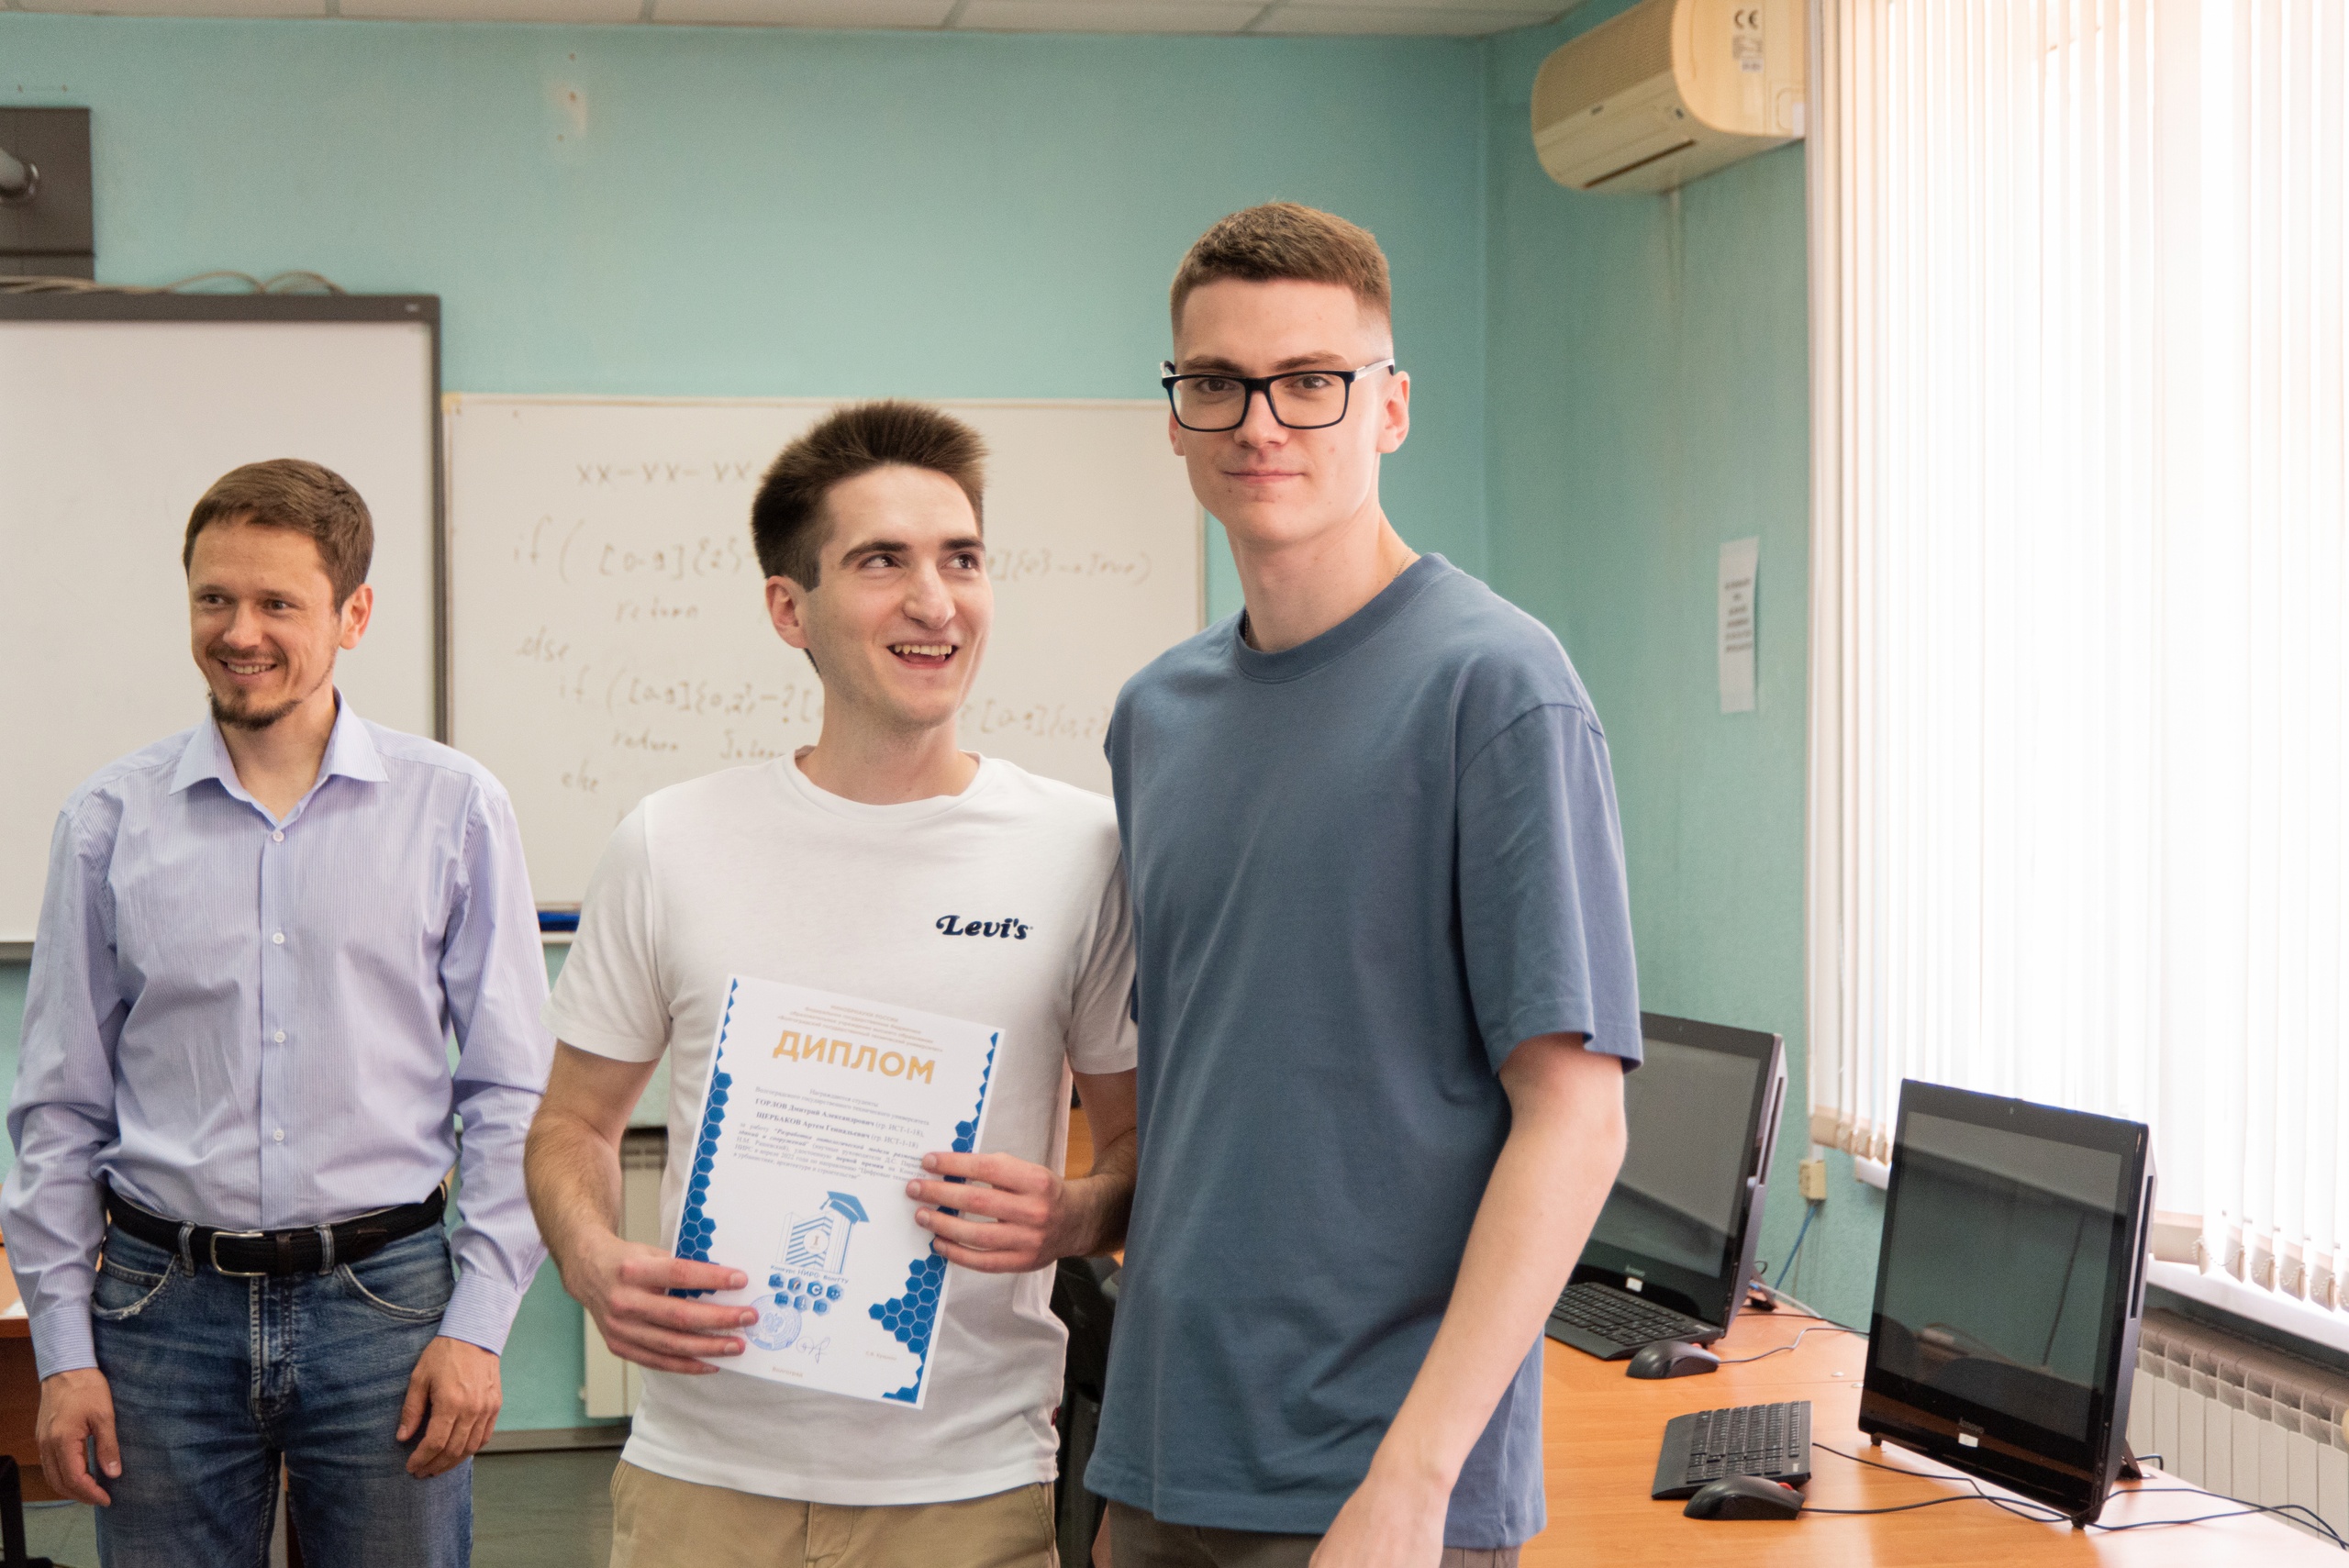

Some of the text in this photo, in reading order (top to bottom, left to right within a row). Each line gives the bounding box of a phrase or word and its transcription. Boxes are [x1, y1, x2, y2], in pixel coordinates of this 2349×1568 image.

[935, 914, 1030, 940] Levi's
[772, 1029, 936, 1084] ДИПЛОМ
[755, 1097, 787, 1109] ГОРЛОВ
[788, 1105, 819, 1116] Дмитрий
[821, 1111, 874, 1127] Александрович
[756, 1110, 801, 1126] ЩЕРБАКОВ
[802, 1120, 824, 1130] Артем
[825, 1125, 870, 1139] Геннадьевич
